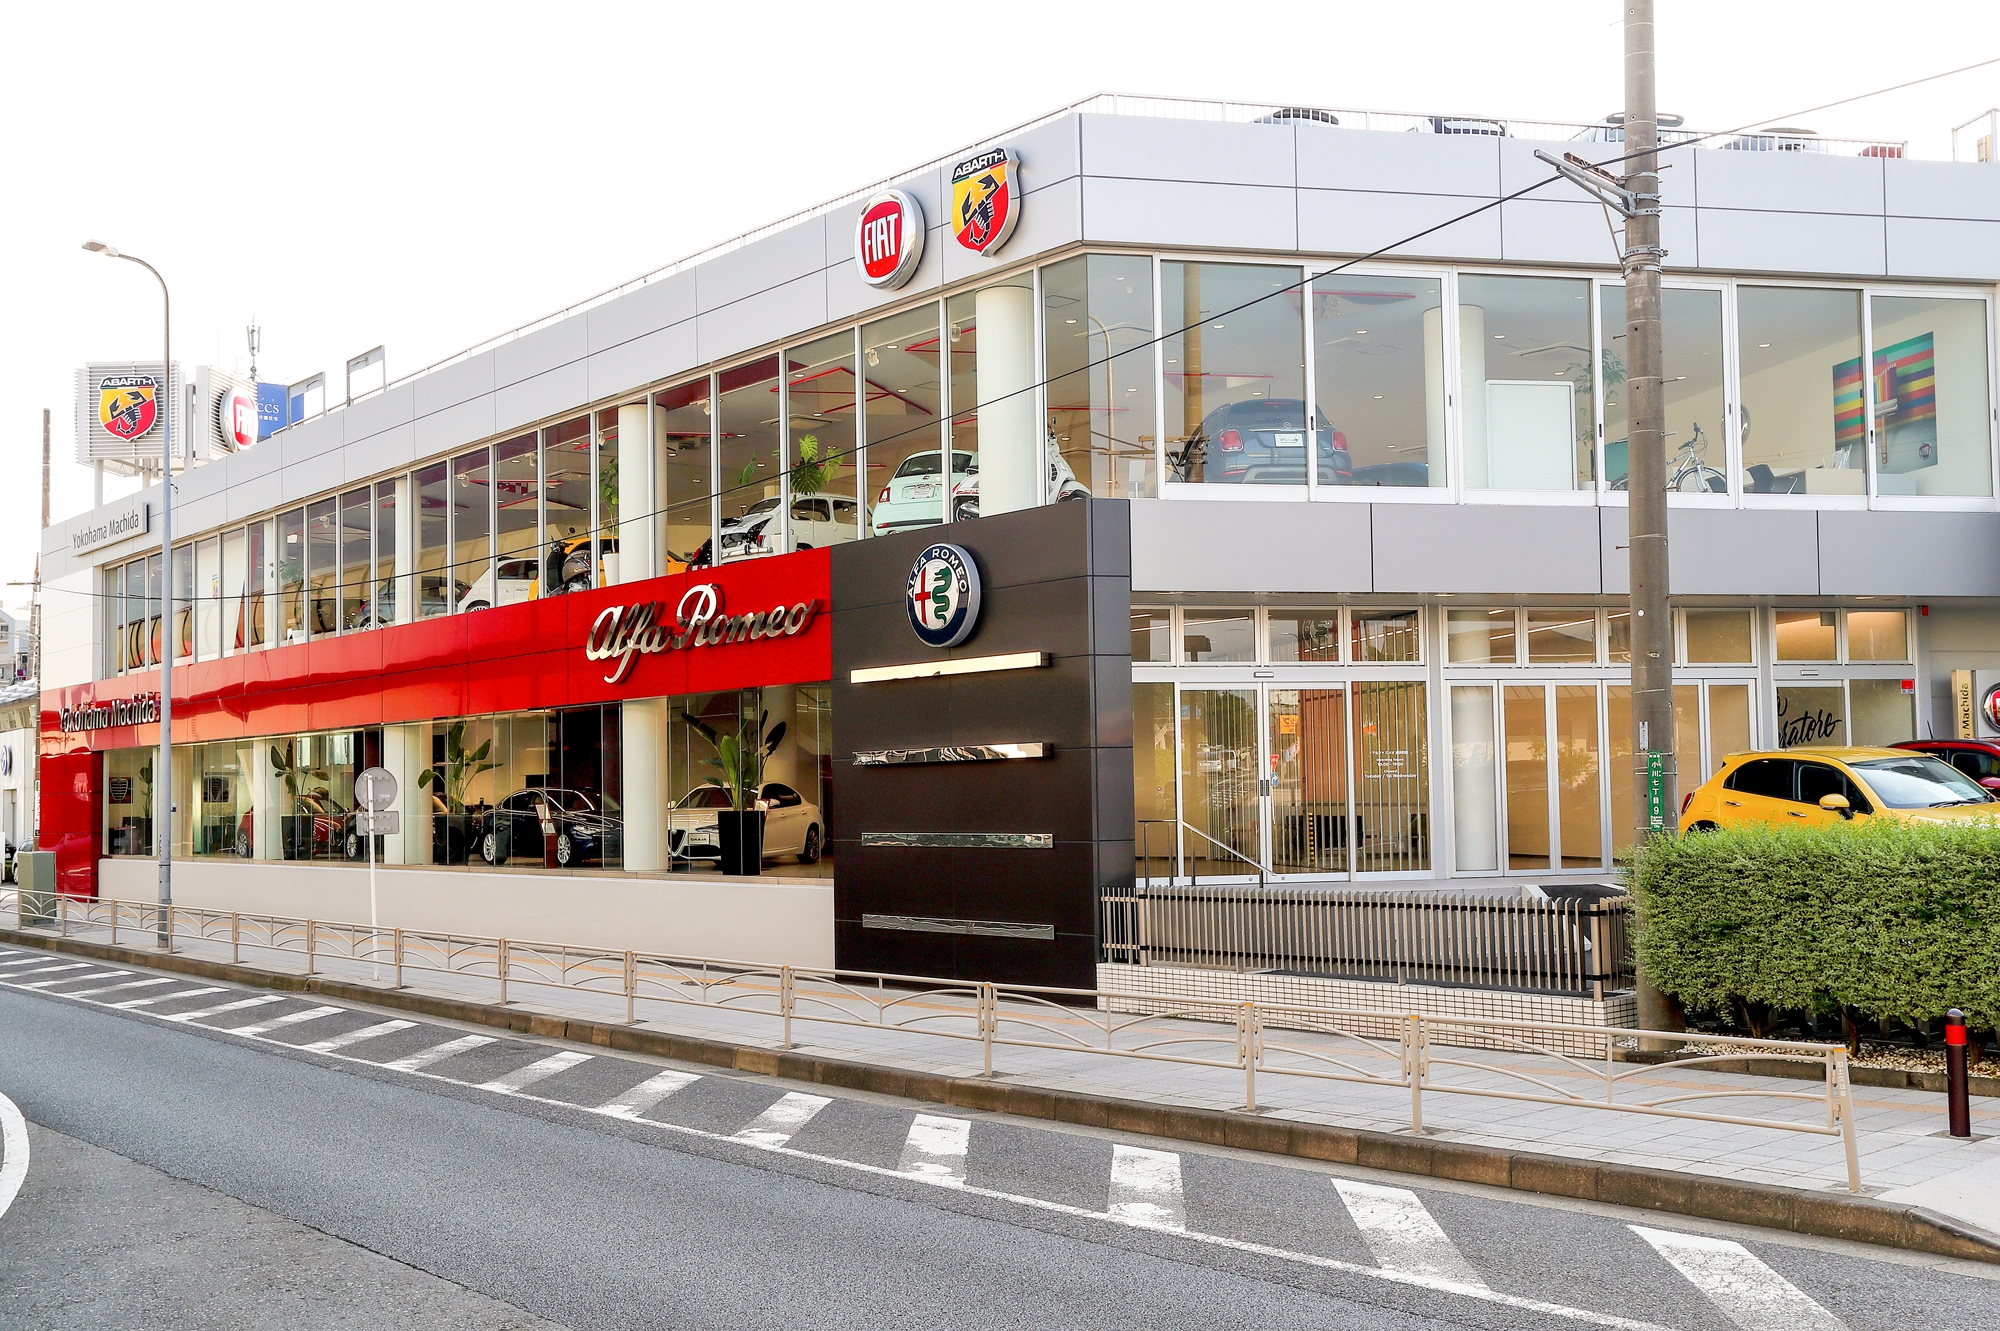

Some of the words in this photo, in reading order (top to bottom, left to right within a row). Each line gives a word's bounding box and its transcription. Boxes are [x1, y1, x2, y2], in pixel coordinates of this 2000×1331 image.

[953, 151, 1005, 179] ABARTH
[864, 212, 898, 265] FIAT
[102, 377, 153, 387] ABARTH
[73, 525, 108, 550] Yokohama
[109, 509, 139, 537] Machida
[907, 556, 927, 599] ALFA
[931, 547, 968, 593] ROMEO
[585, 600, 673, 683] Alfa
[670, 582, 815, 650] Romeo
[58, 703, 109, 733] Yokohama
[110, 691, 155, 728] Machida
[1960, 683, 1971, 730] Machida
